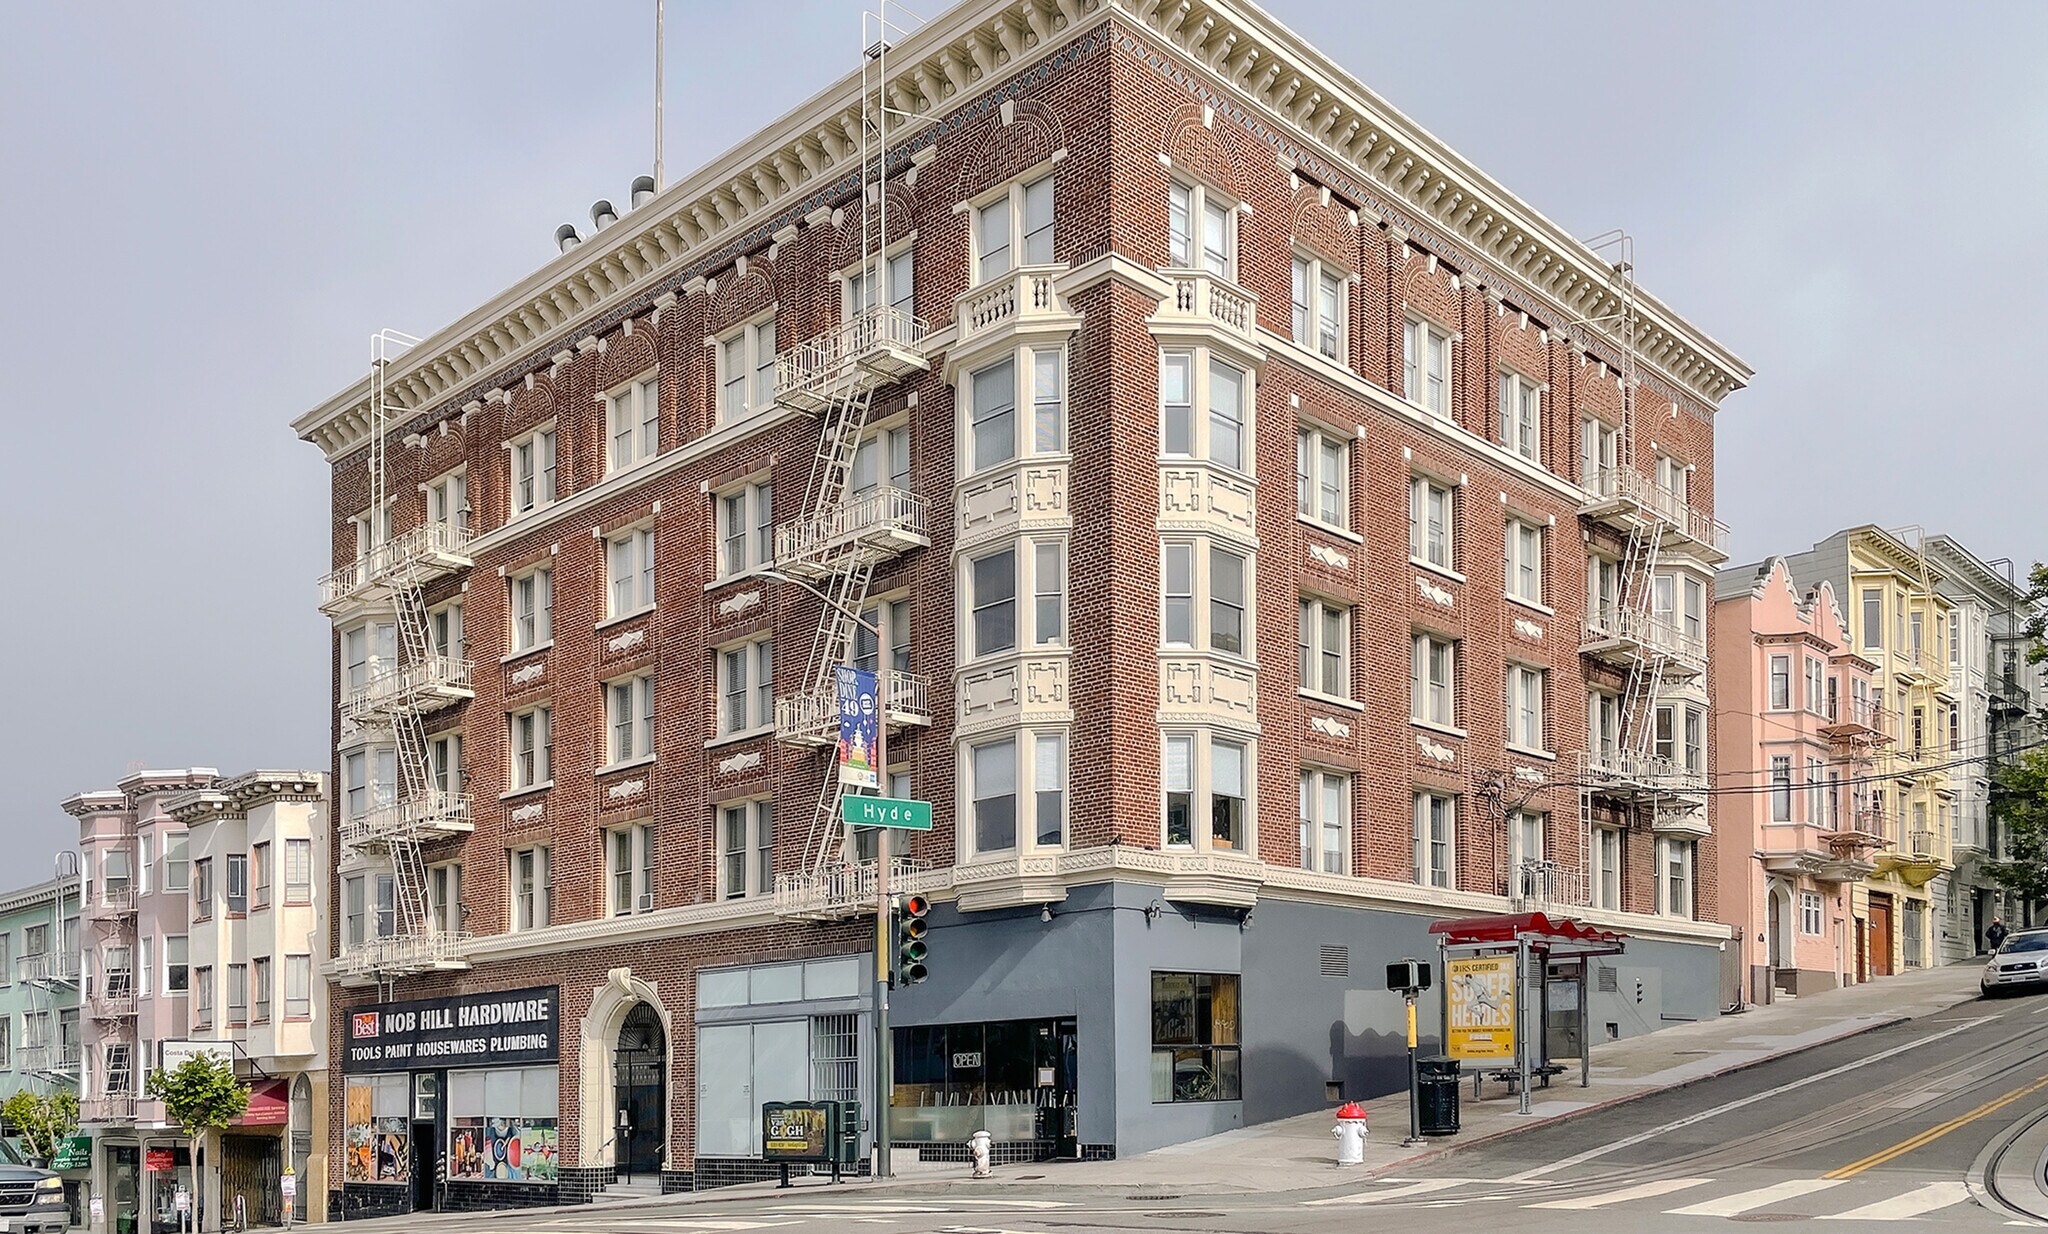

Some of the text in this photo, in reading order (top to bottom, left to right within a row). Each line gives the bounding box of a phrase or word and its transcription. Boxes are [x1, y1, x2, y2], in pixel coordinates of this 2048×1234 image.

[863, 803, 912, 822] Hyde
[1472, 963, 1498, 972] CERTIFIED
[385, 999, 549, 1033] NOB HILL HARDWARE
[354, 1018, 376, 1036] Best
[351, 1033, 548, 1061] TOOLS PAINT HOUSEWARES PLUMBING
[954, 1054, 980, 1067] OPEN
[68, 1148, 88, 1157] Nails
